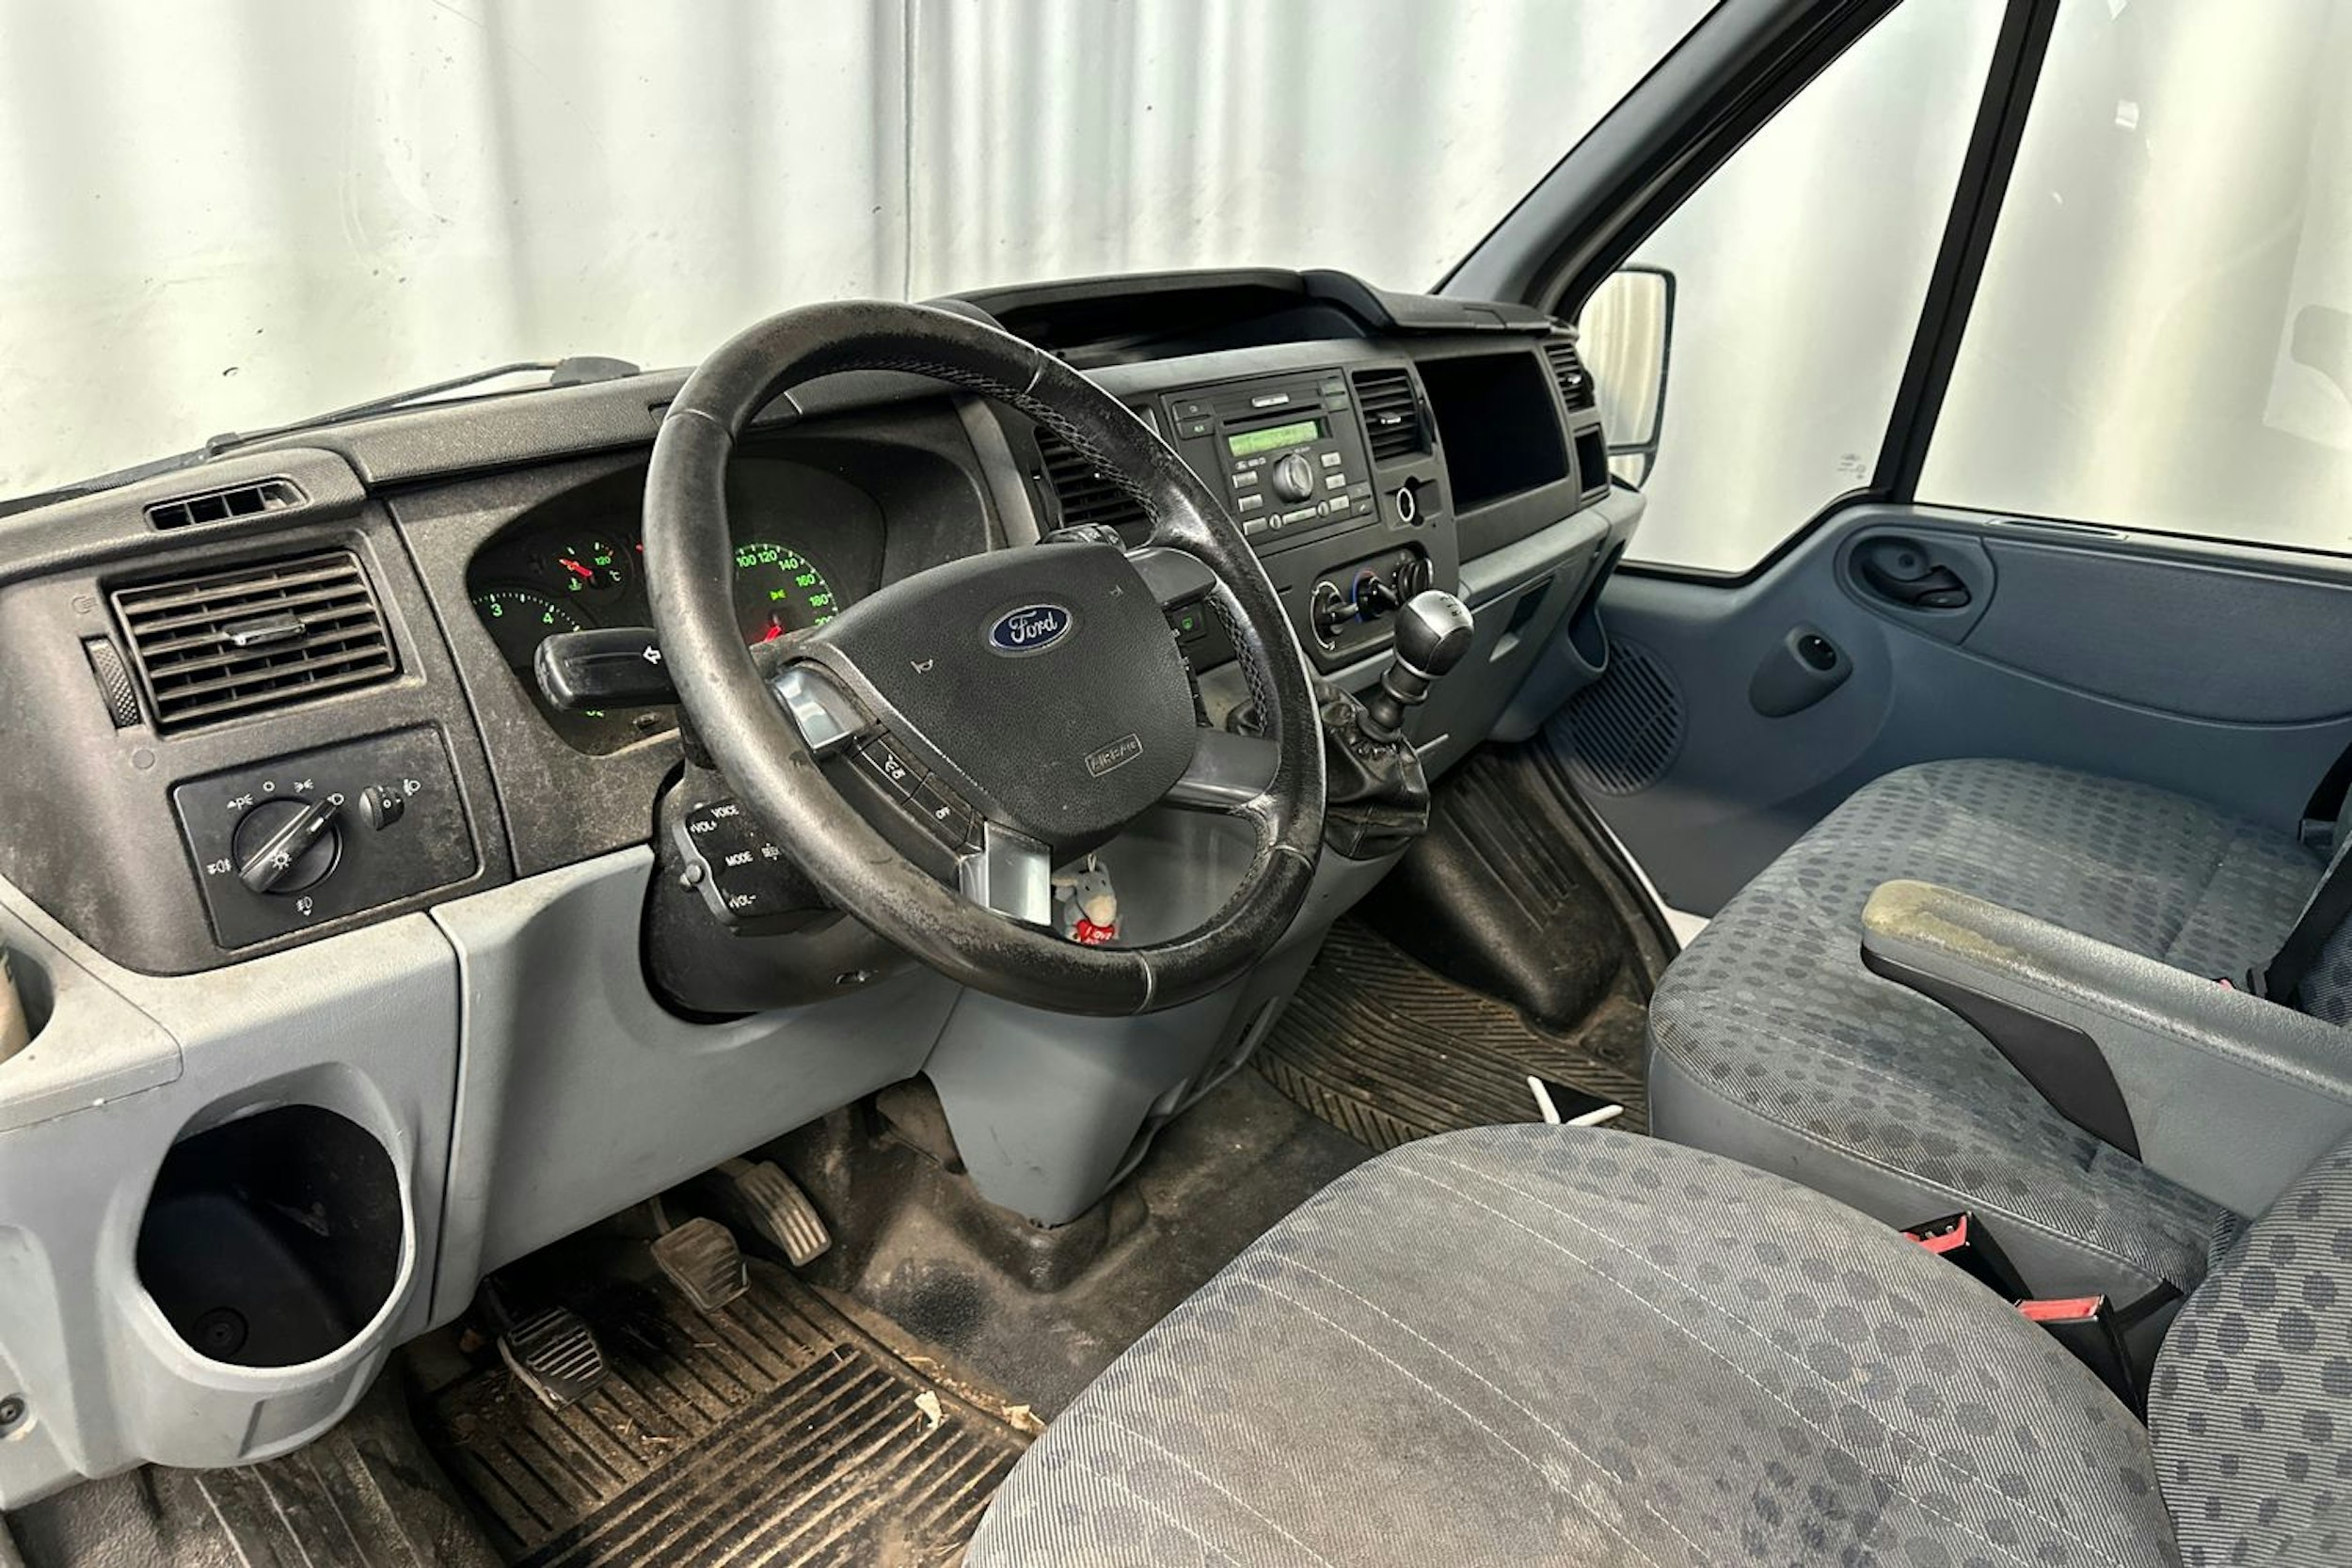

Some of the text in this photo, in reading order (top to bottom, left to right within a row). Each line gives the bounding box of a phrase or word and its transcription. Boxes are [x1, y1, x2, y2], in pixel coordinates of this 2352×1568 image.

[595, 556, 612, 566] 120
[737, 554, 756, 567] 100
[757, 549, 778, 563] 120
[778, 558, 799, 571] 140
[796, 573, 816, 588] 160
[809, 594, 829, 607] 180
[490, 603, 502, 617] 3
[542, 612, 554, 625] 4
[814, 616, 833, 626] 20
[1008, 610, 1058, 643] Ford
[710, 804, 739, 818] VOICE
[725, 851, 754, 866] MODE
